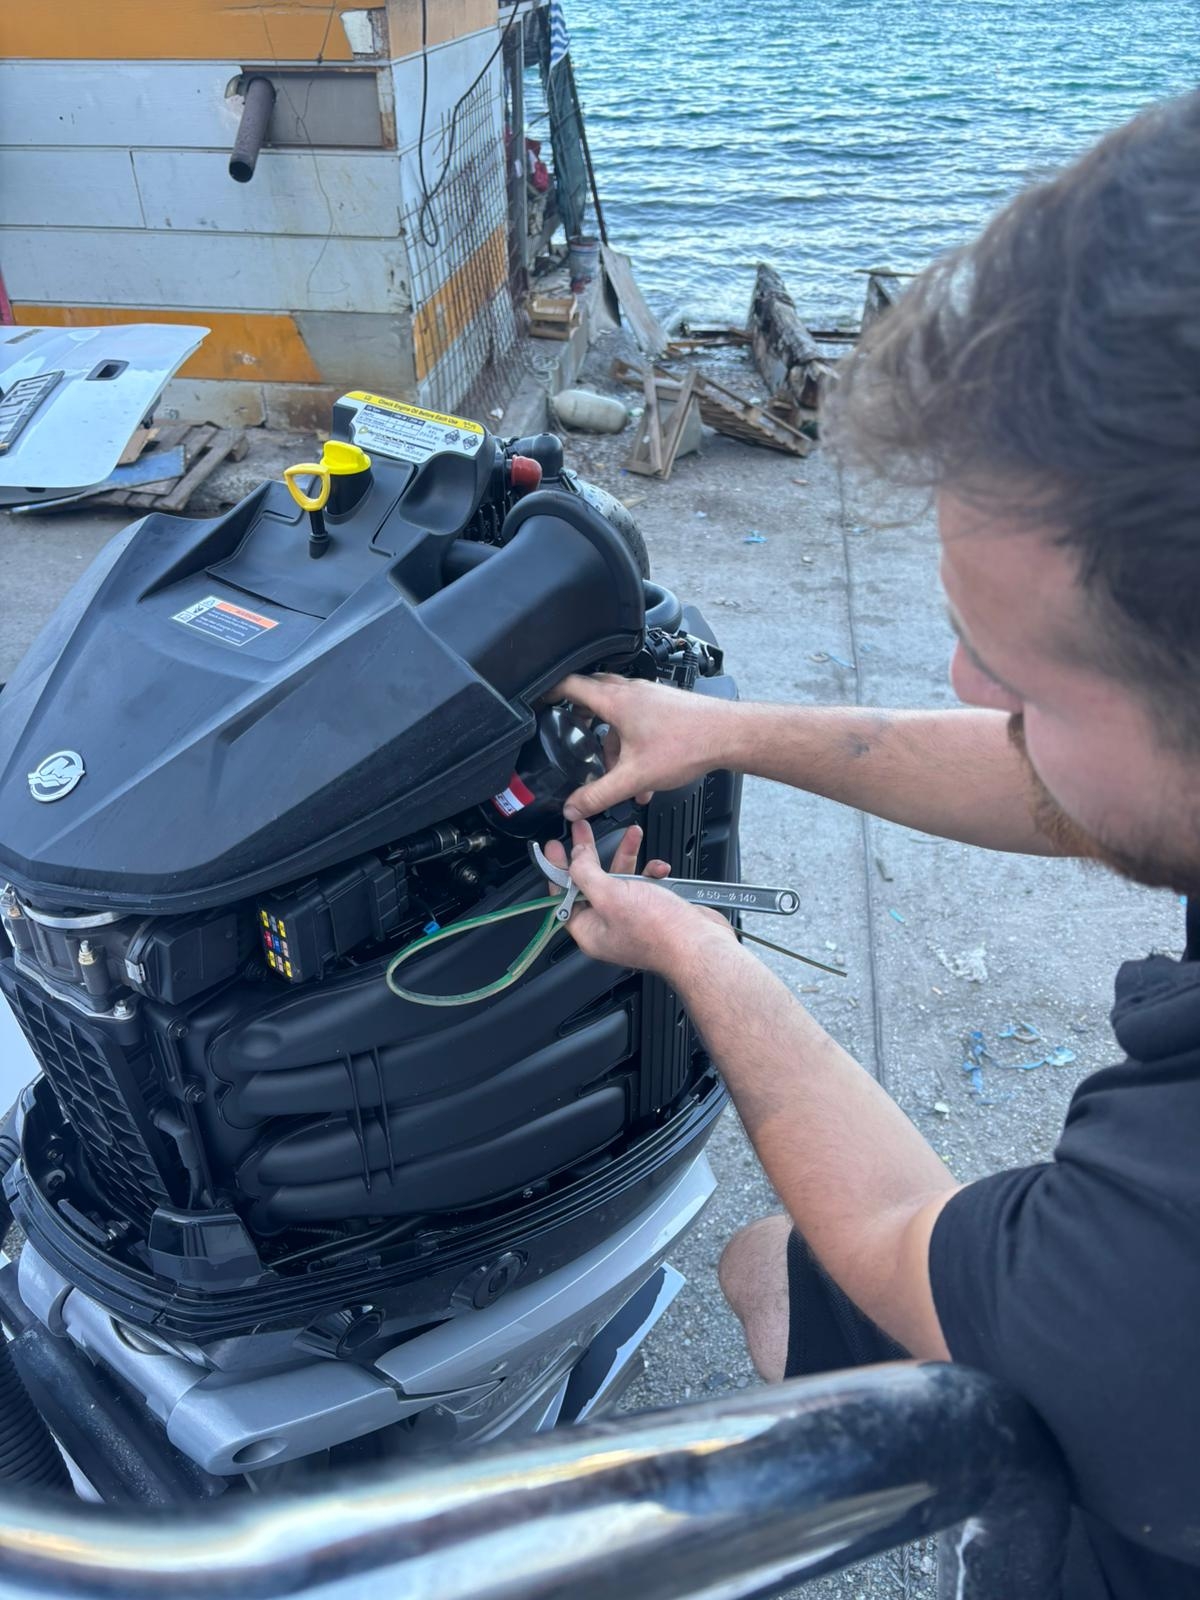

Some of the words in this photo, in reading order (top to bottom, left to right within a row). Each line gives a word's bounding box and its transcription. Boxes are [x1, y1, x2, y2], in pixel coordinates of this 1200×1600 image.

[378, 399, 394, 407] Check
[394, 403, 411, 412] Engine
[419, 410, 435, 418] Before
